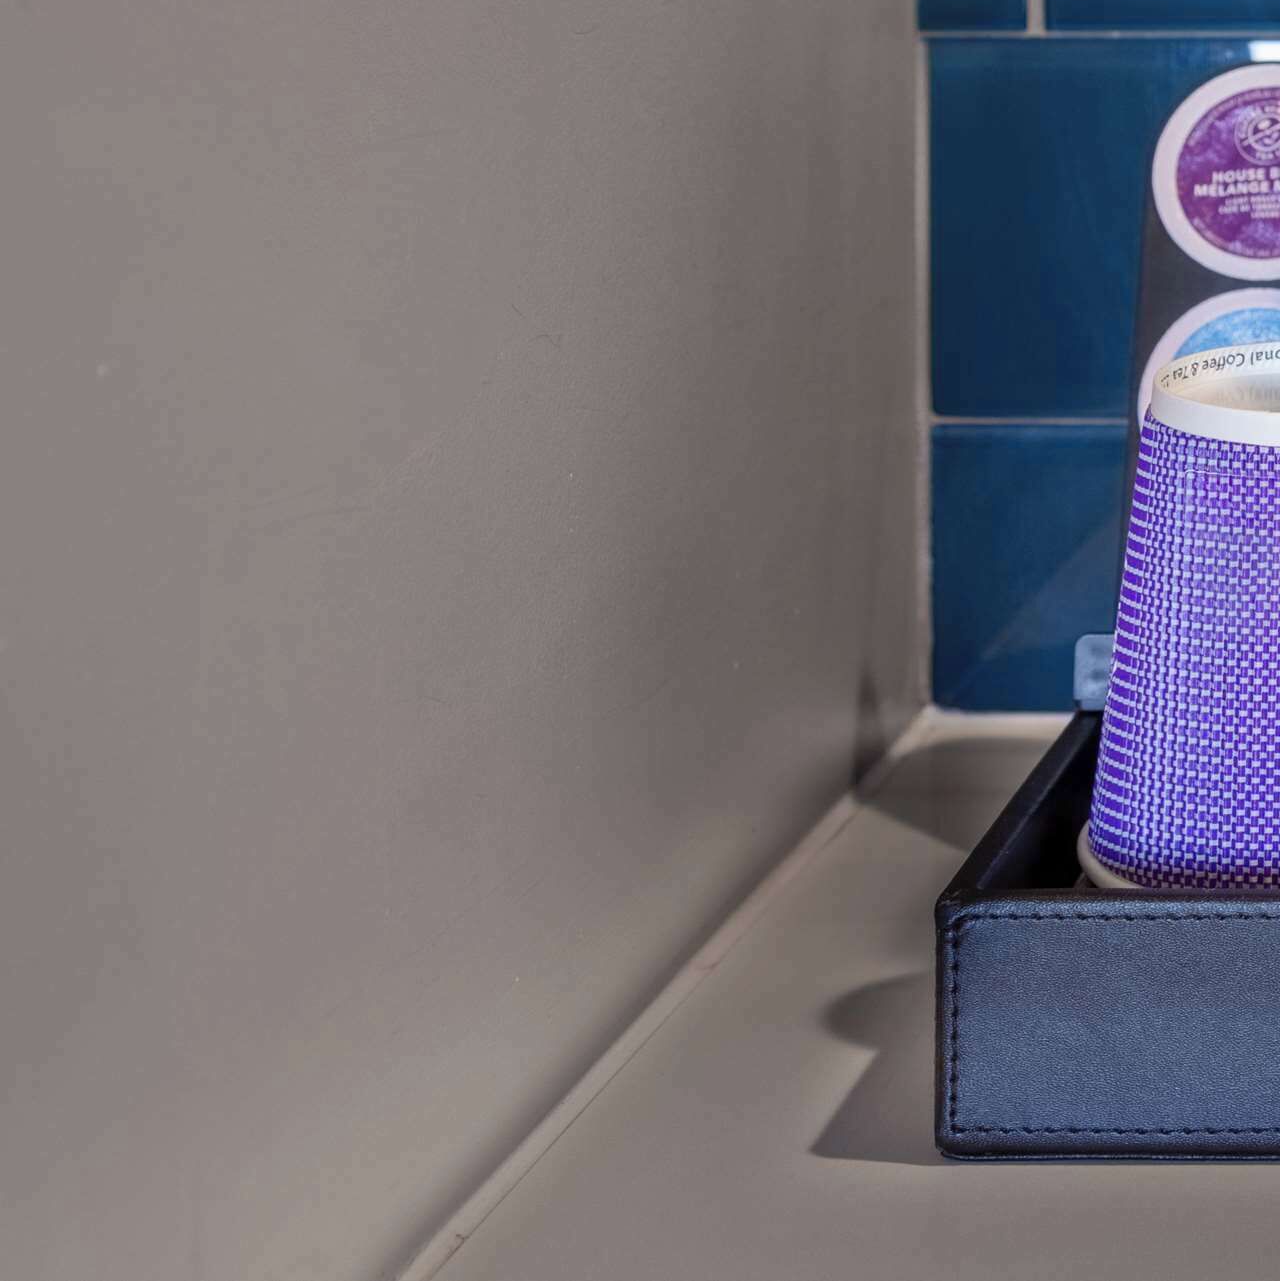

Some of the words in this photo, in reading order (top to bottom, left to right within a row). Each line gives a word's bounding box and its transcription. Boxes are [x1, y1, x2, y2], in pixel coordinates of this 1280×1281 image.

[1211, 167, 1266, 184] HOUSE
[1191, 361, 1199, 376] &
[1201, 352, 1246, 372] Coffee
[1173, 367, 1189, 380] Tea
